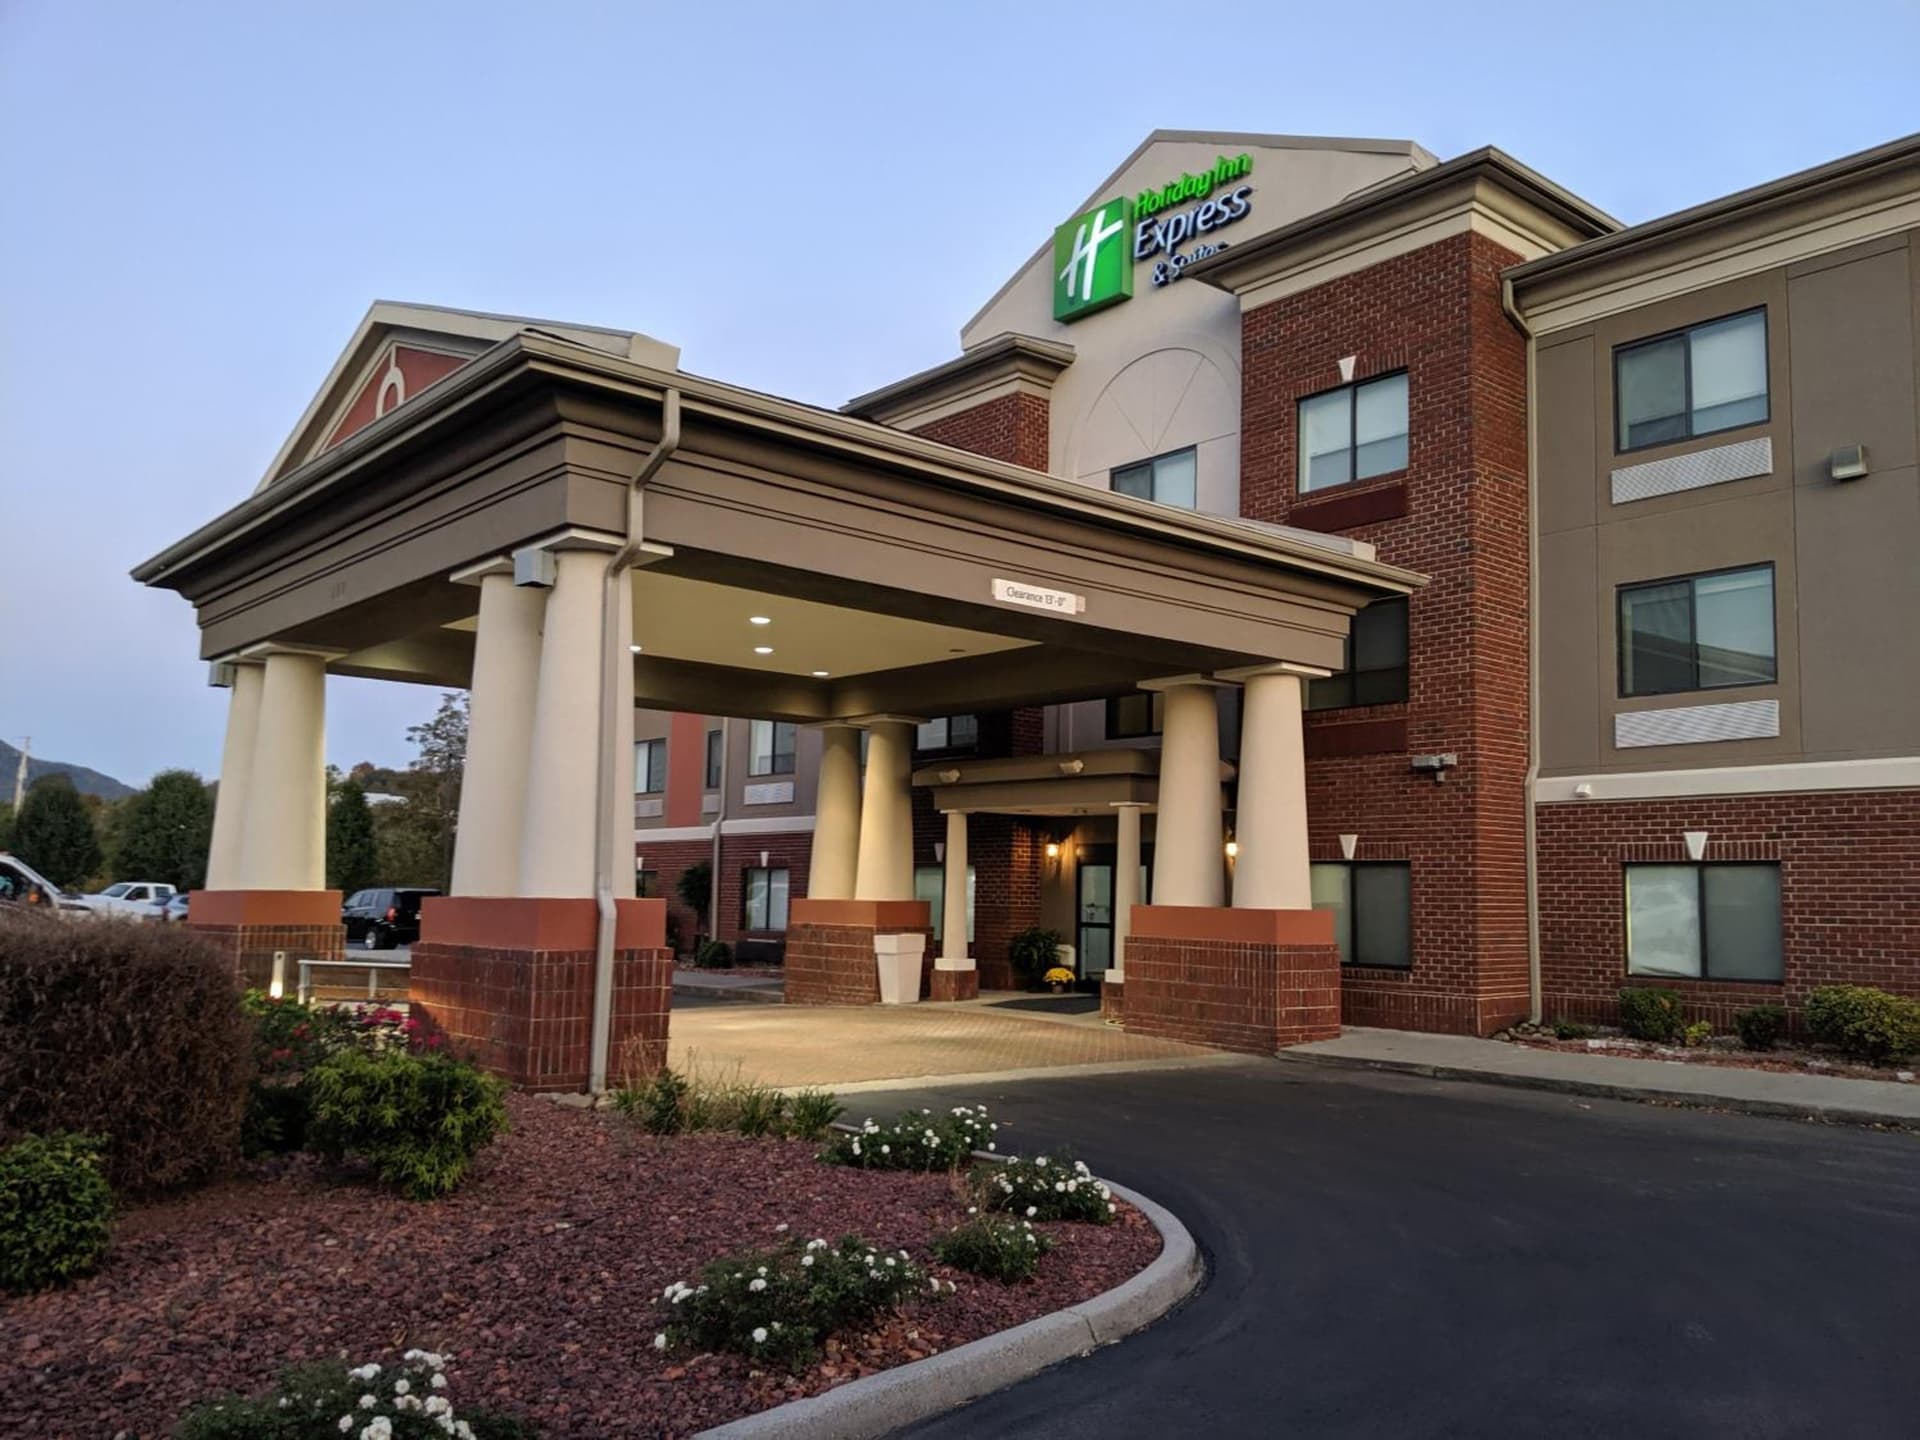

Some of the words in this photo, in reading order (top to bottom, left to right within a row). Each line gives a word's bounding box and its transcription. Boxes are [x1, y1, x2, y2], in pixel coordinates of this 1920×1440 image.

[1135, 172, 1214, 217] Holiday
[1214, 153, 1253, 186] Inn
[1135, 186, 1252, 260] Express
[1152, 261, 1168, 285] &
[1006, 586, 1043, 603] Clearance
